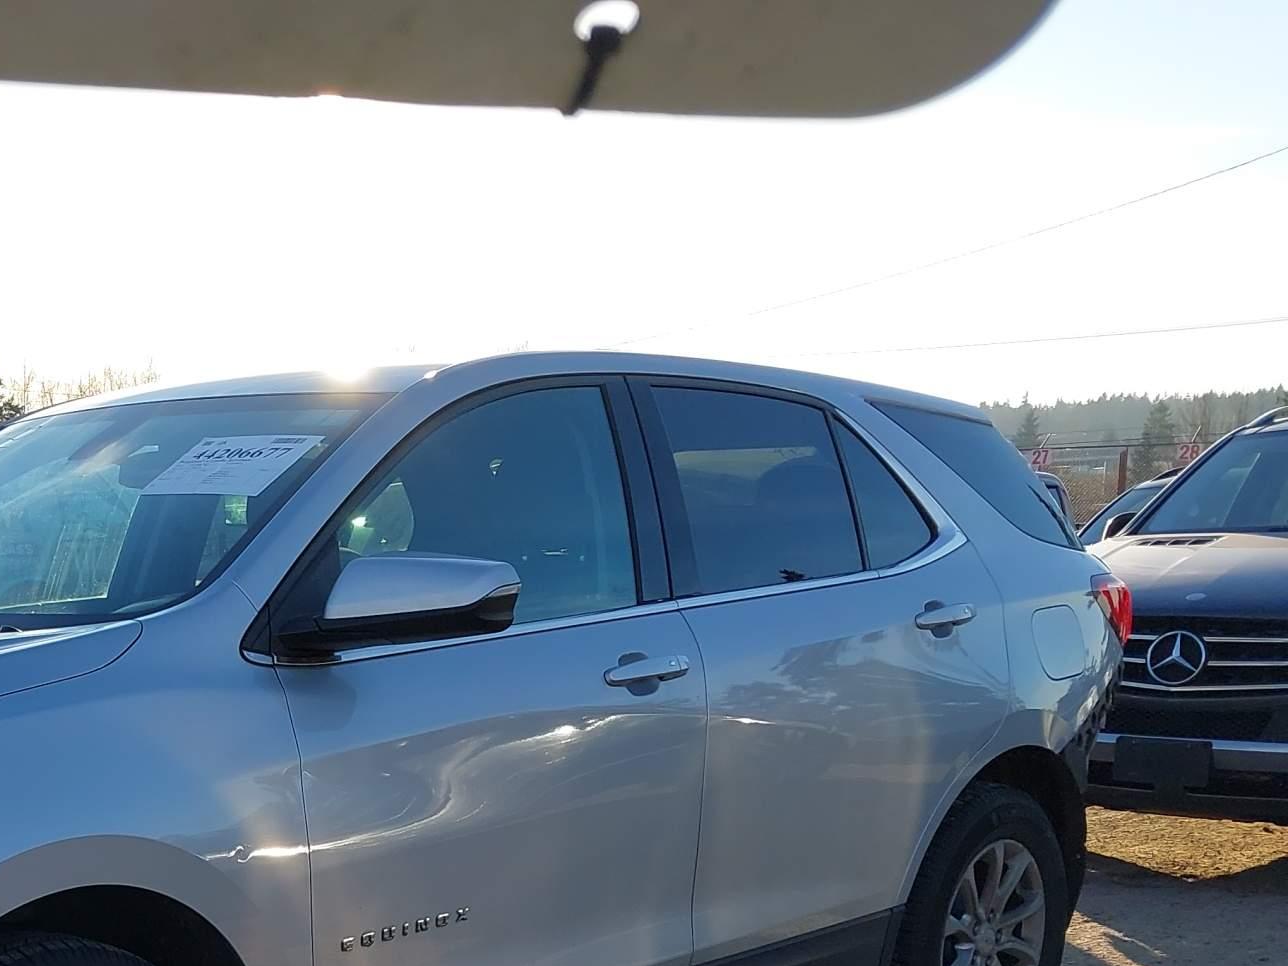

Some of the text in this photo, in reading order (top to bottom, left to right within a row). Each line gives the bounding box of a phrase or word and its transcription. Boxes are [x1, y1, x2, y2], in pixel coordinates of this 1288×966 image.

[193, 447, 295, 460] 44206677
[1032, 449, 1049, 465] 27
[1179, 444, 1201, 460] 28
[341, 906, 471, 953] EQUINOX
